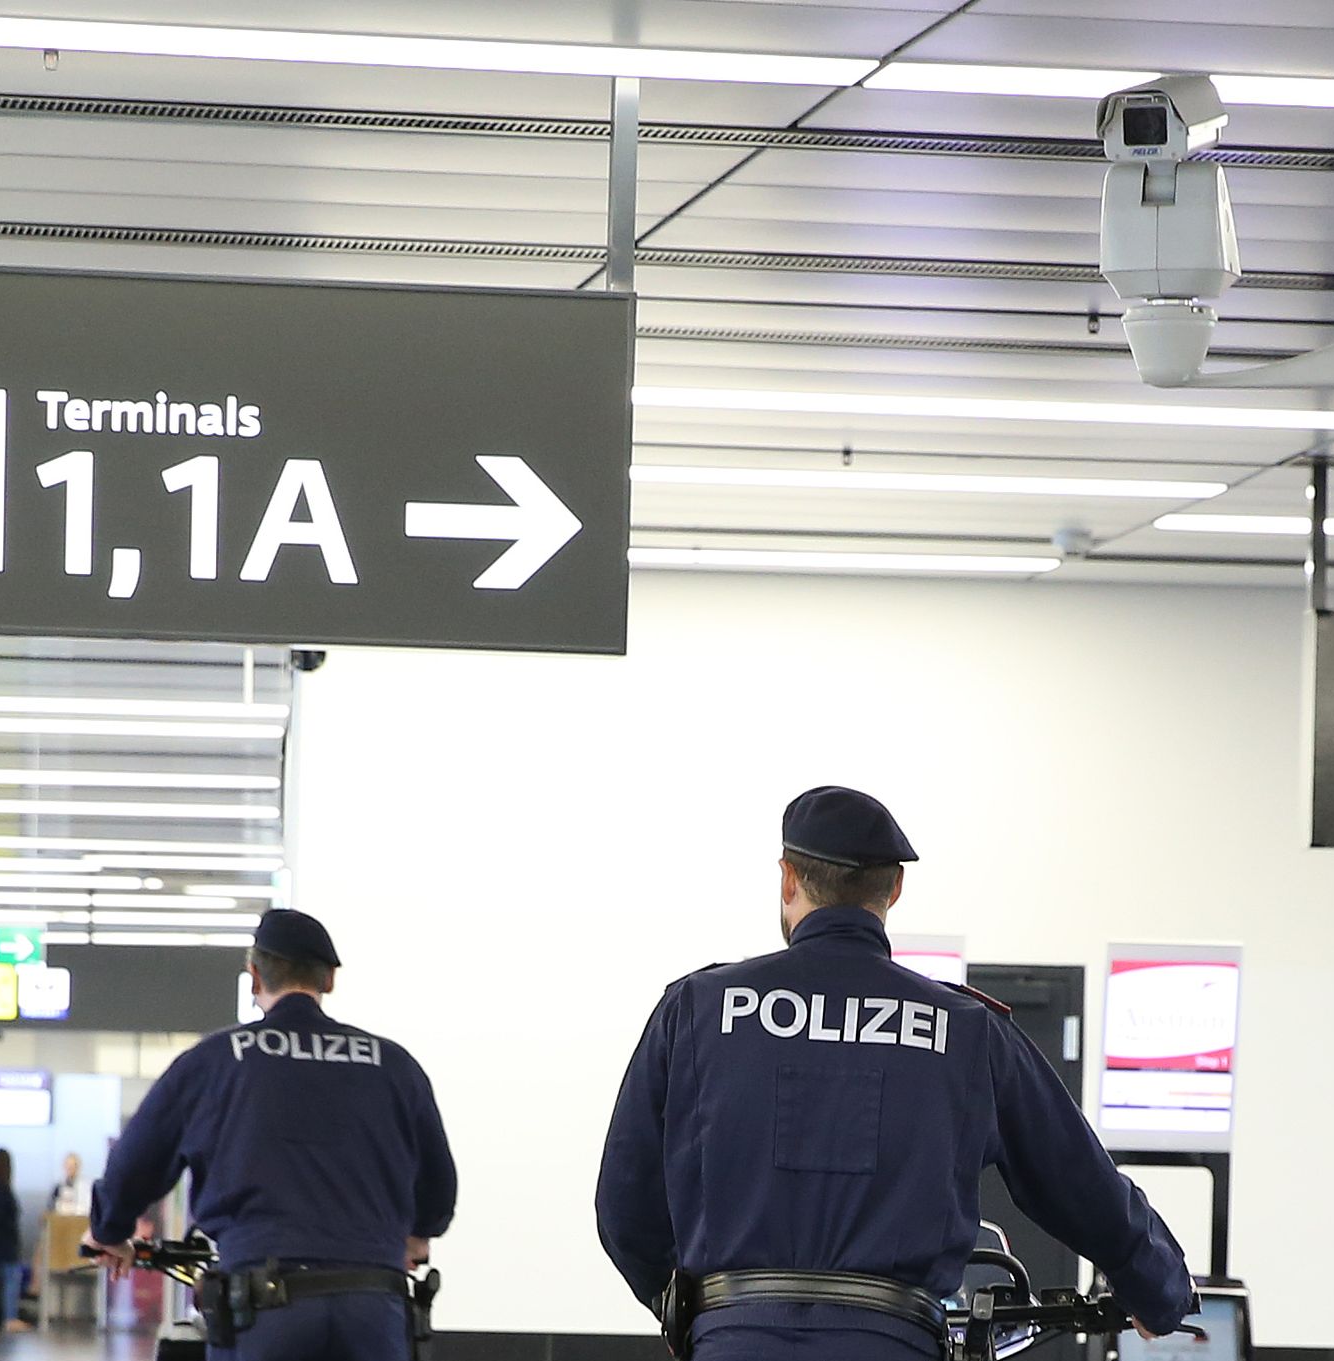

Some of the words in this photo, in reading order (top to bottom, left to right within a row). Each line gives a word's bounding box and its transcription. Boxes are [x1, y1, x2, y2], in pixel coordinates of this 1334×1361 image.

[37, 389, 262, 438] Terminals
[720, 986, 949, 1055] POLIZEI
[230, 1029, 382, 1067] POLIZEI
